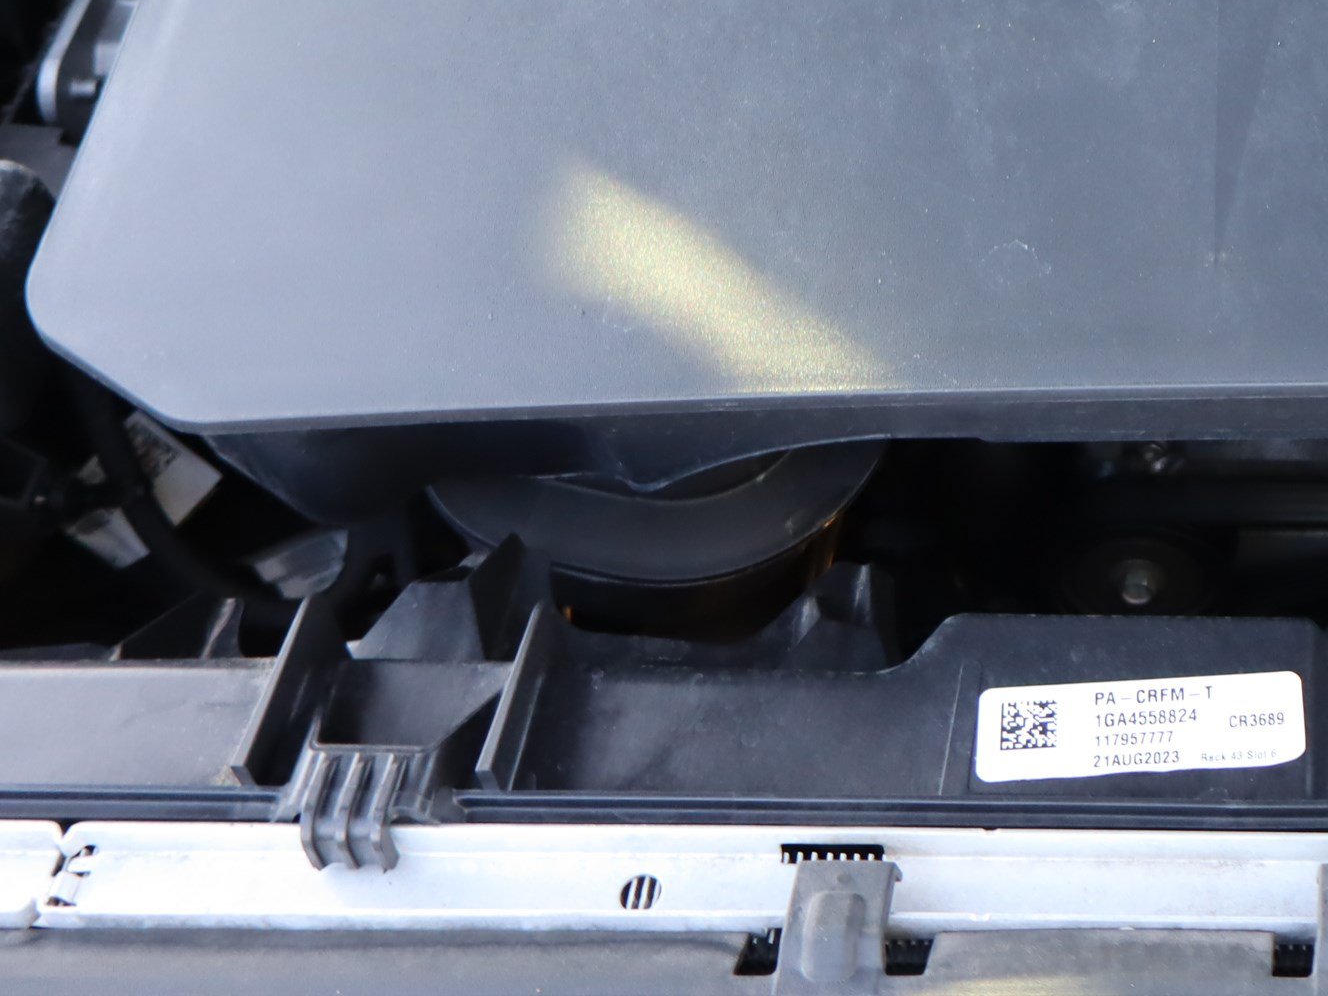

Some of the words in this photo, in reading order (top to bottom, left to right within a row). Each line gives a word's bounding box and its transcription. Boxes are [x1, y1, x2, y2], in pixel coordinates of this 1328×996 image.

[1096, 709, 1198, 728] 1GA4558824
[1229, 712, 1286, 729] CR3689
[1096, 730, 1174, 747] 117957777
[1094, 750, 1181, 768] 21AUG2023
